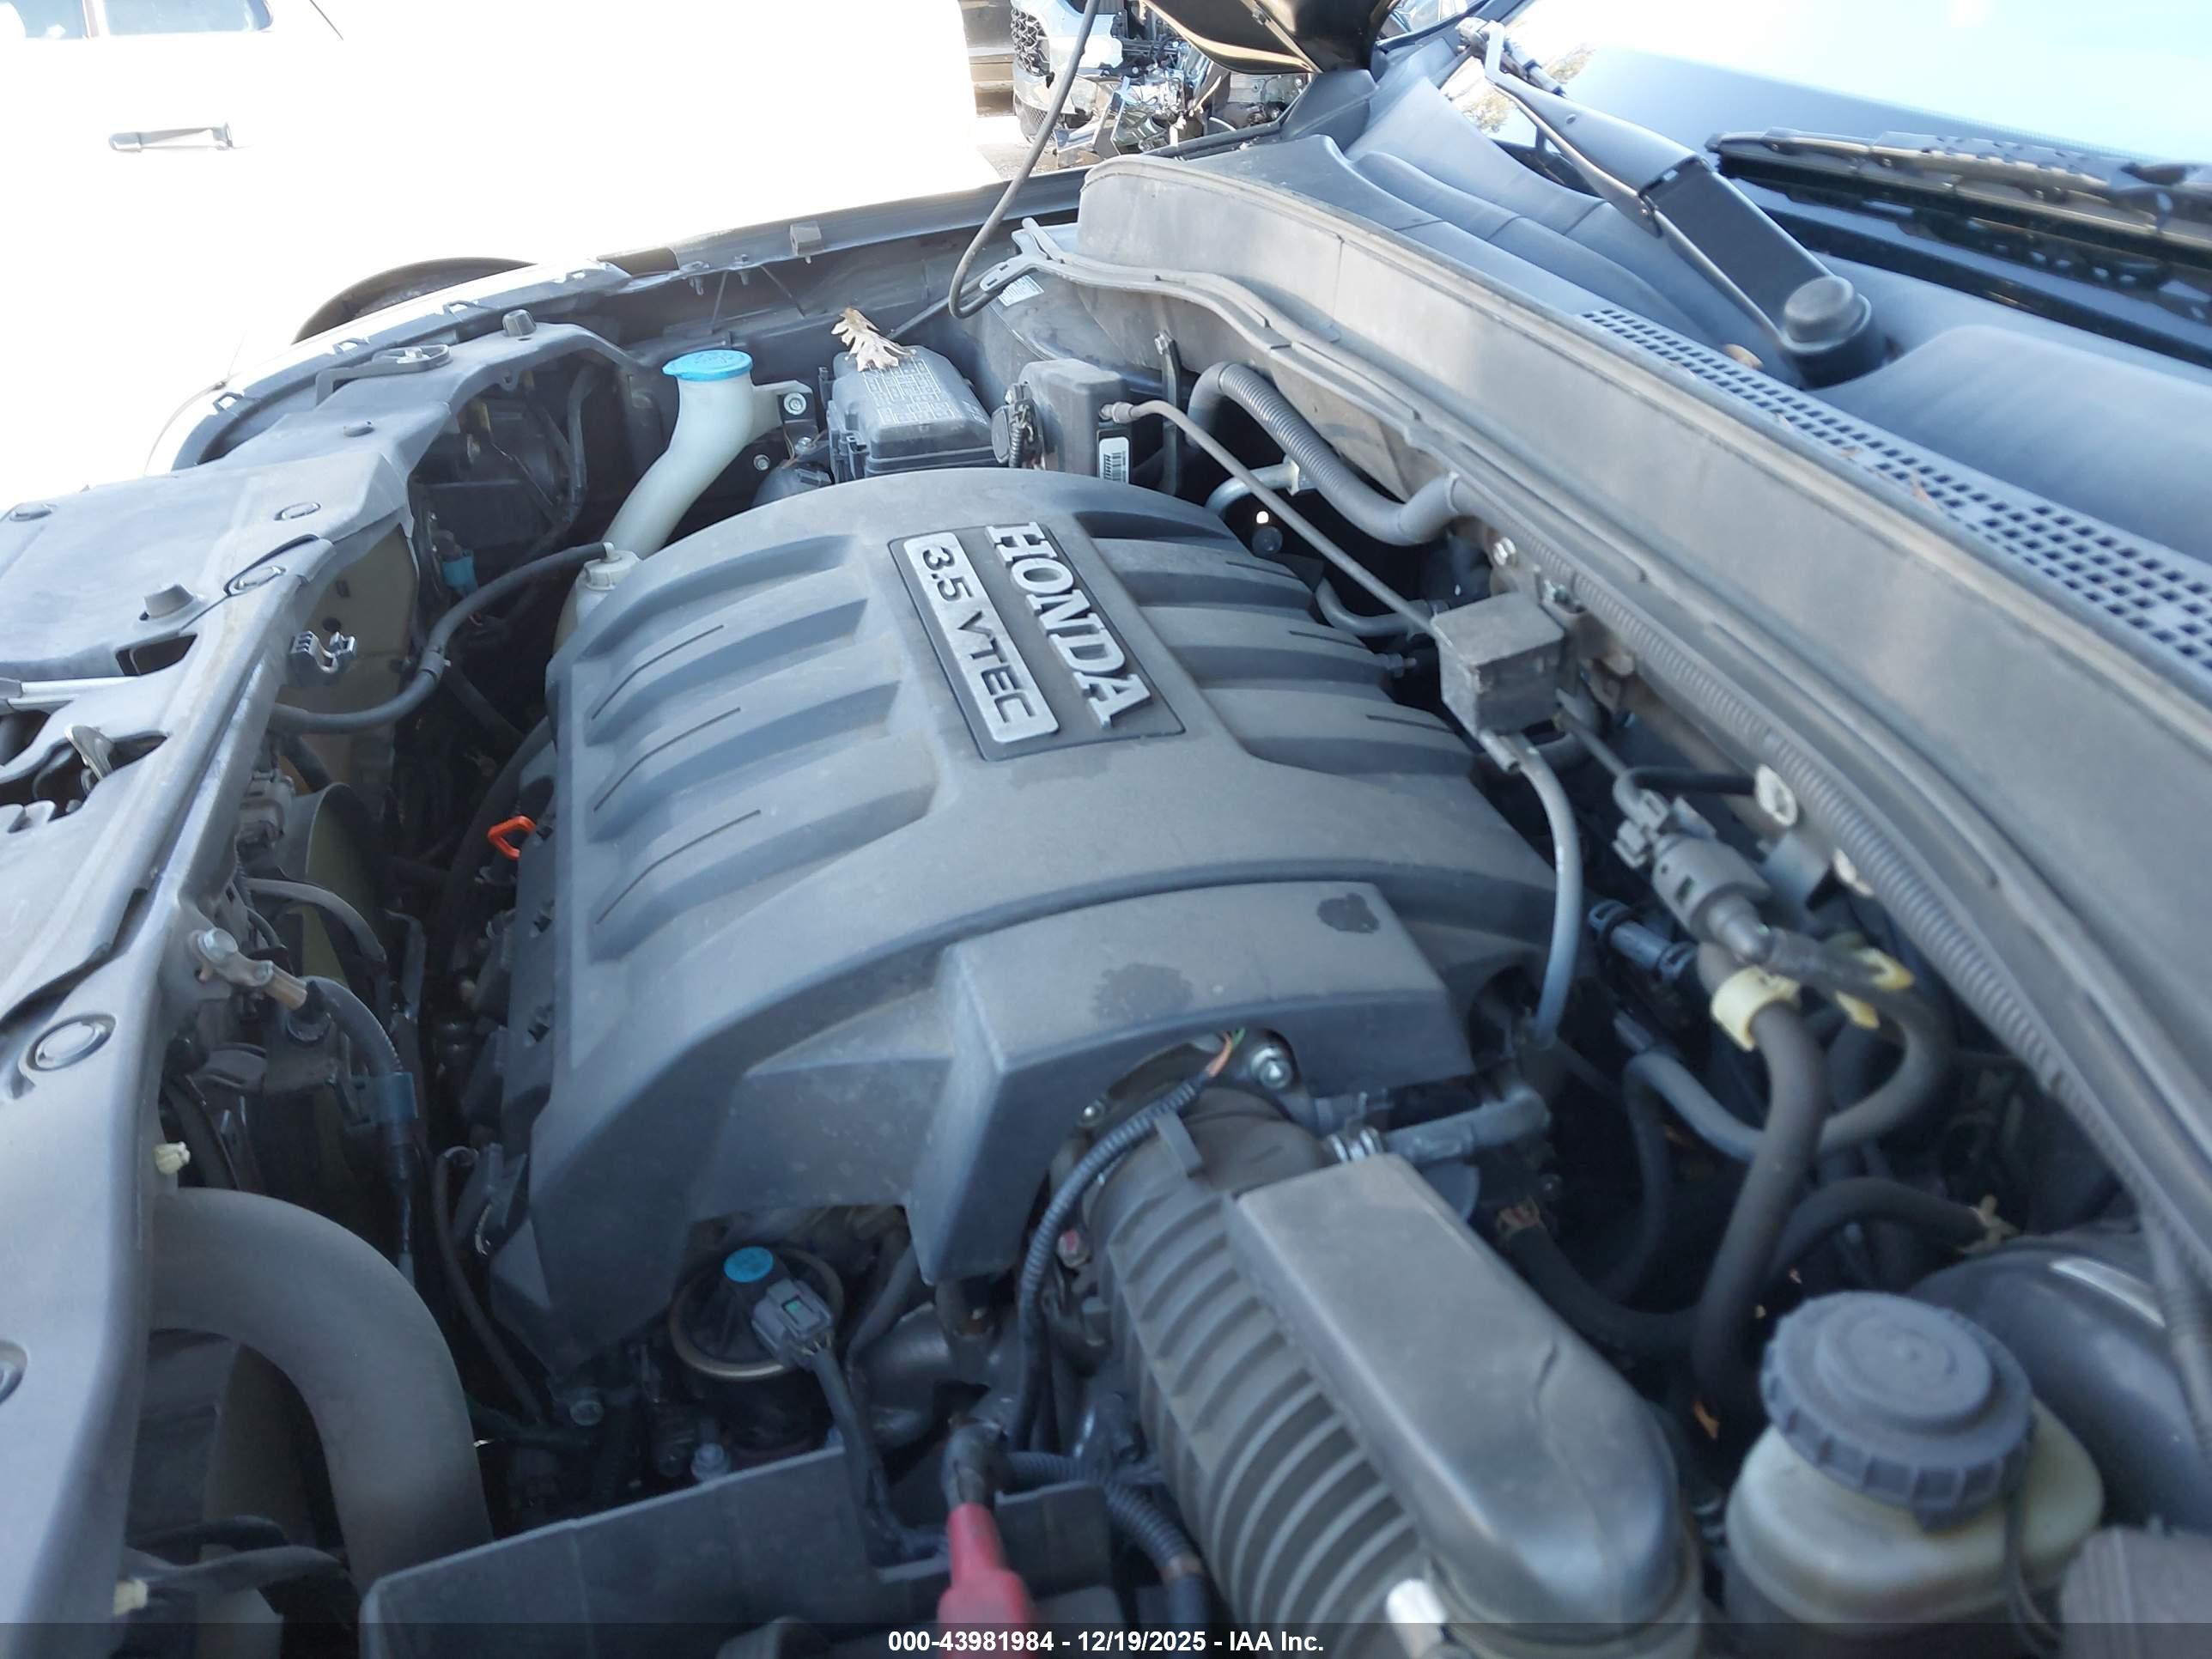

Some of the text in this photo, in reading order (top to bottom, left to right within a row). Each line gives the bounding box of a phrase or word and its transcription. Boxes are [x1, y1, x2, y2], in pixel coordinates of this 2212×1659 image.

[922, 546, 1036, 724] 3.5 VTEC
[986, 521, 1151, 728] HONDA
